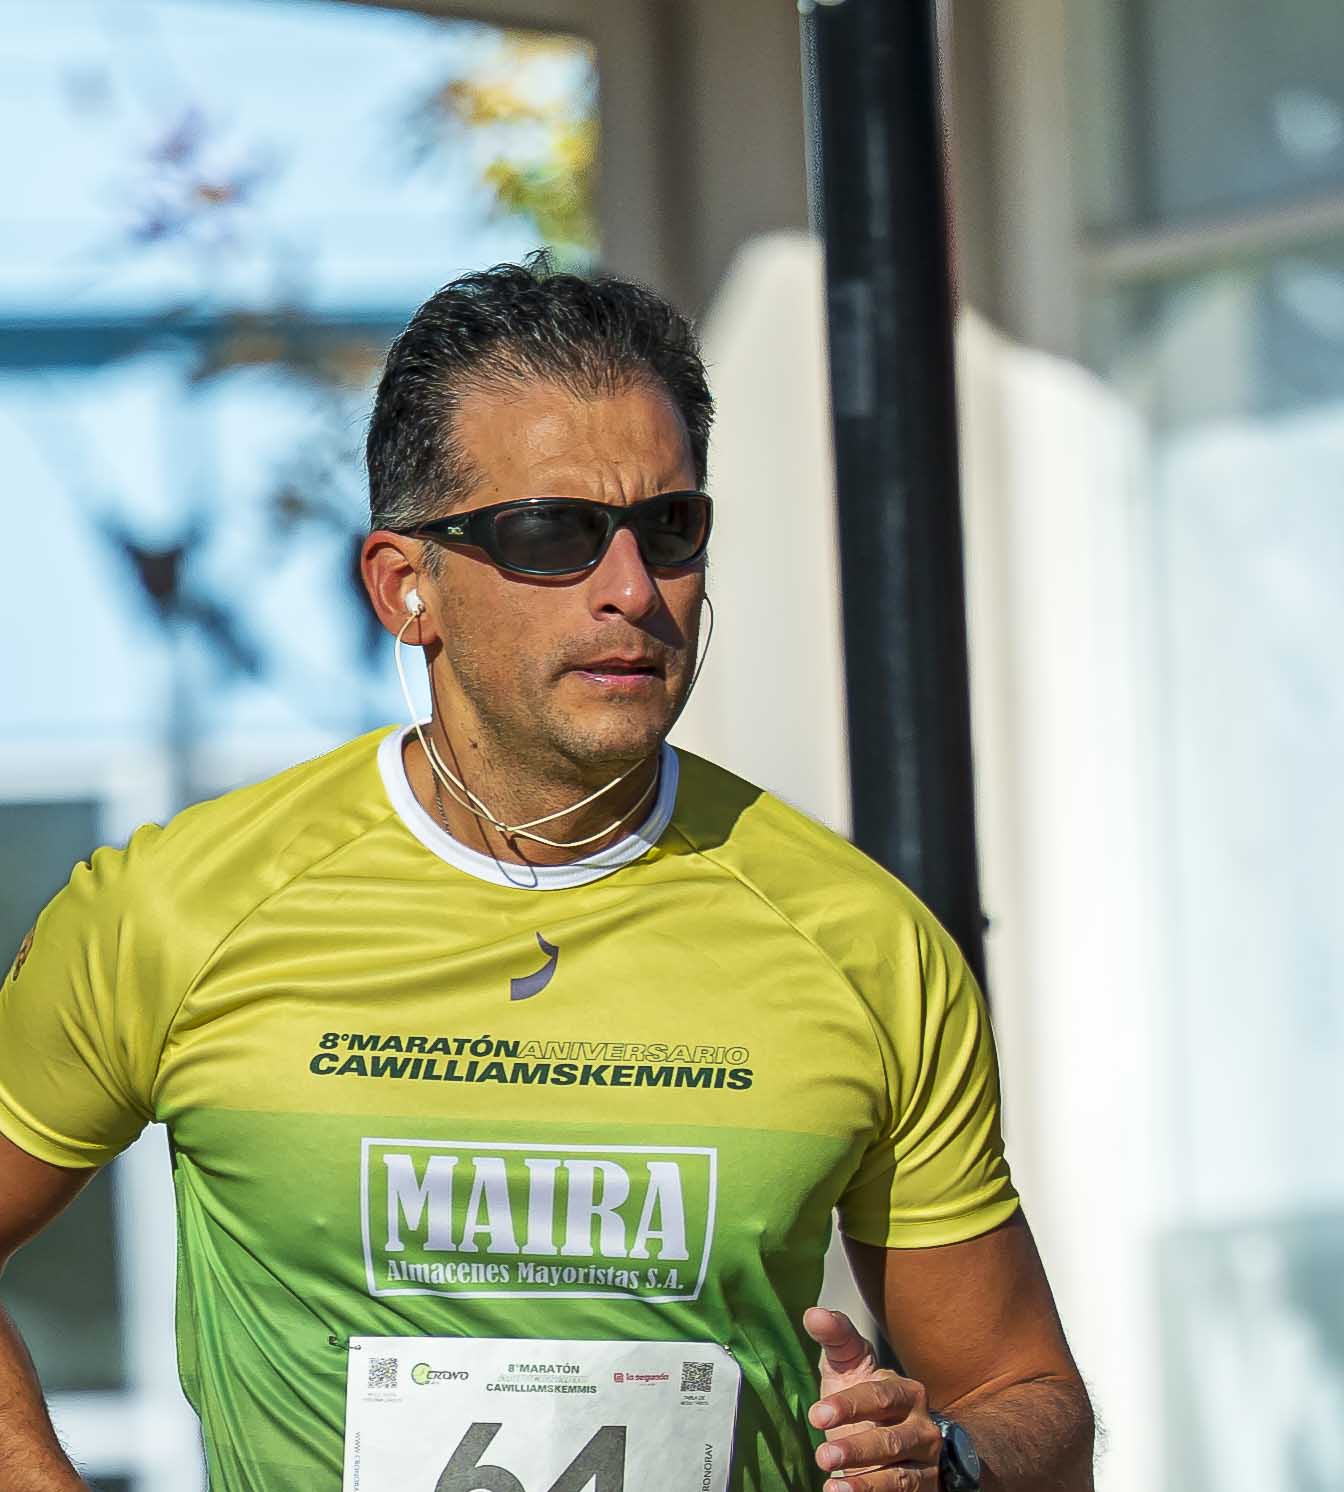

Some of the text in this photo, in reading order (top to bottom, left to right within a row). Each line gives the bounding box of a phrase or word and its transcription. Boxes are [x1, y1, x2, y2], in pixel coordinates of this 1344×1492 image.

[309, 1053, 754, 1090] CAWILLIAMSKEMMIS
[382, 1153, 690, 1261] MAIRA
[386, 1259, 684, 1290] Almacenes Mayoristas S.A.
[485, 1383, 598, 1395] CAWILLIAMSKEMMIS
